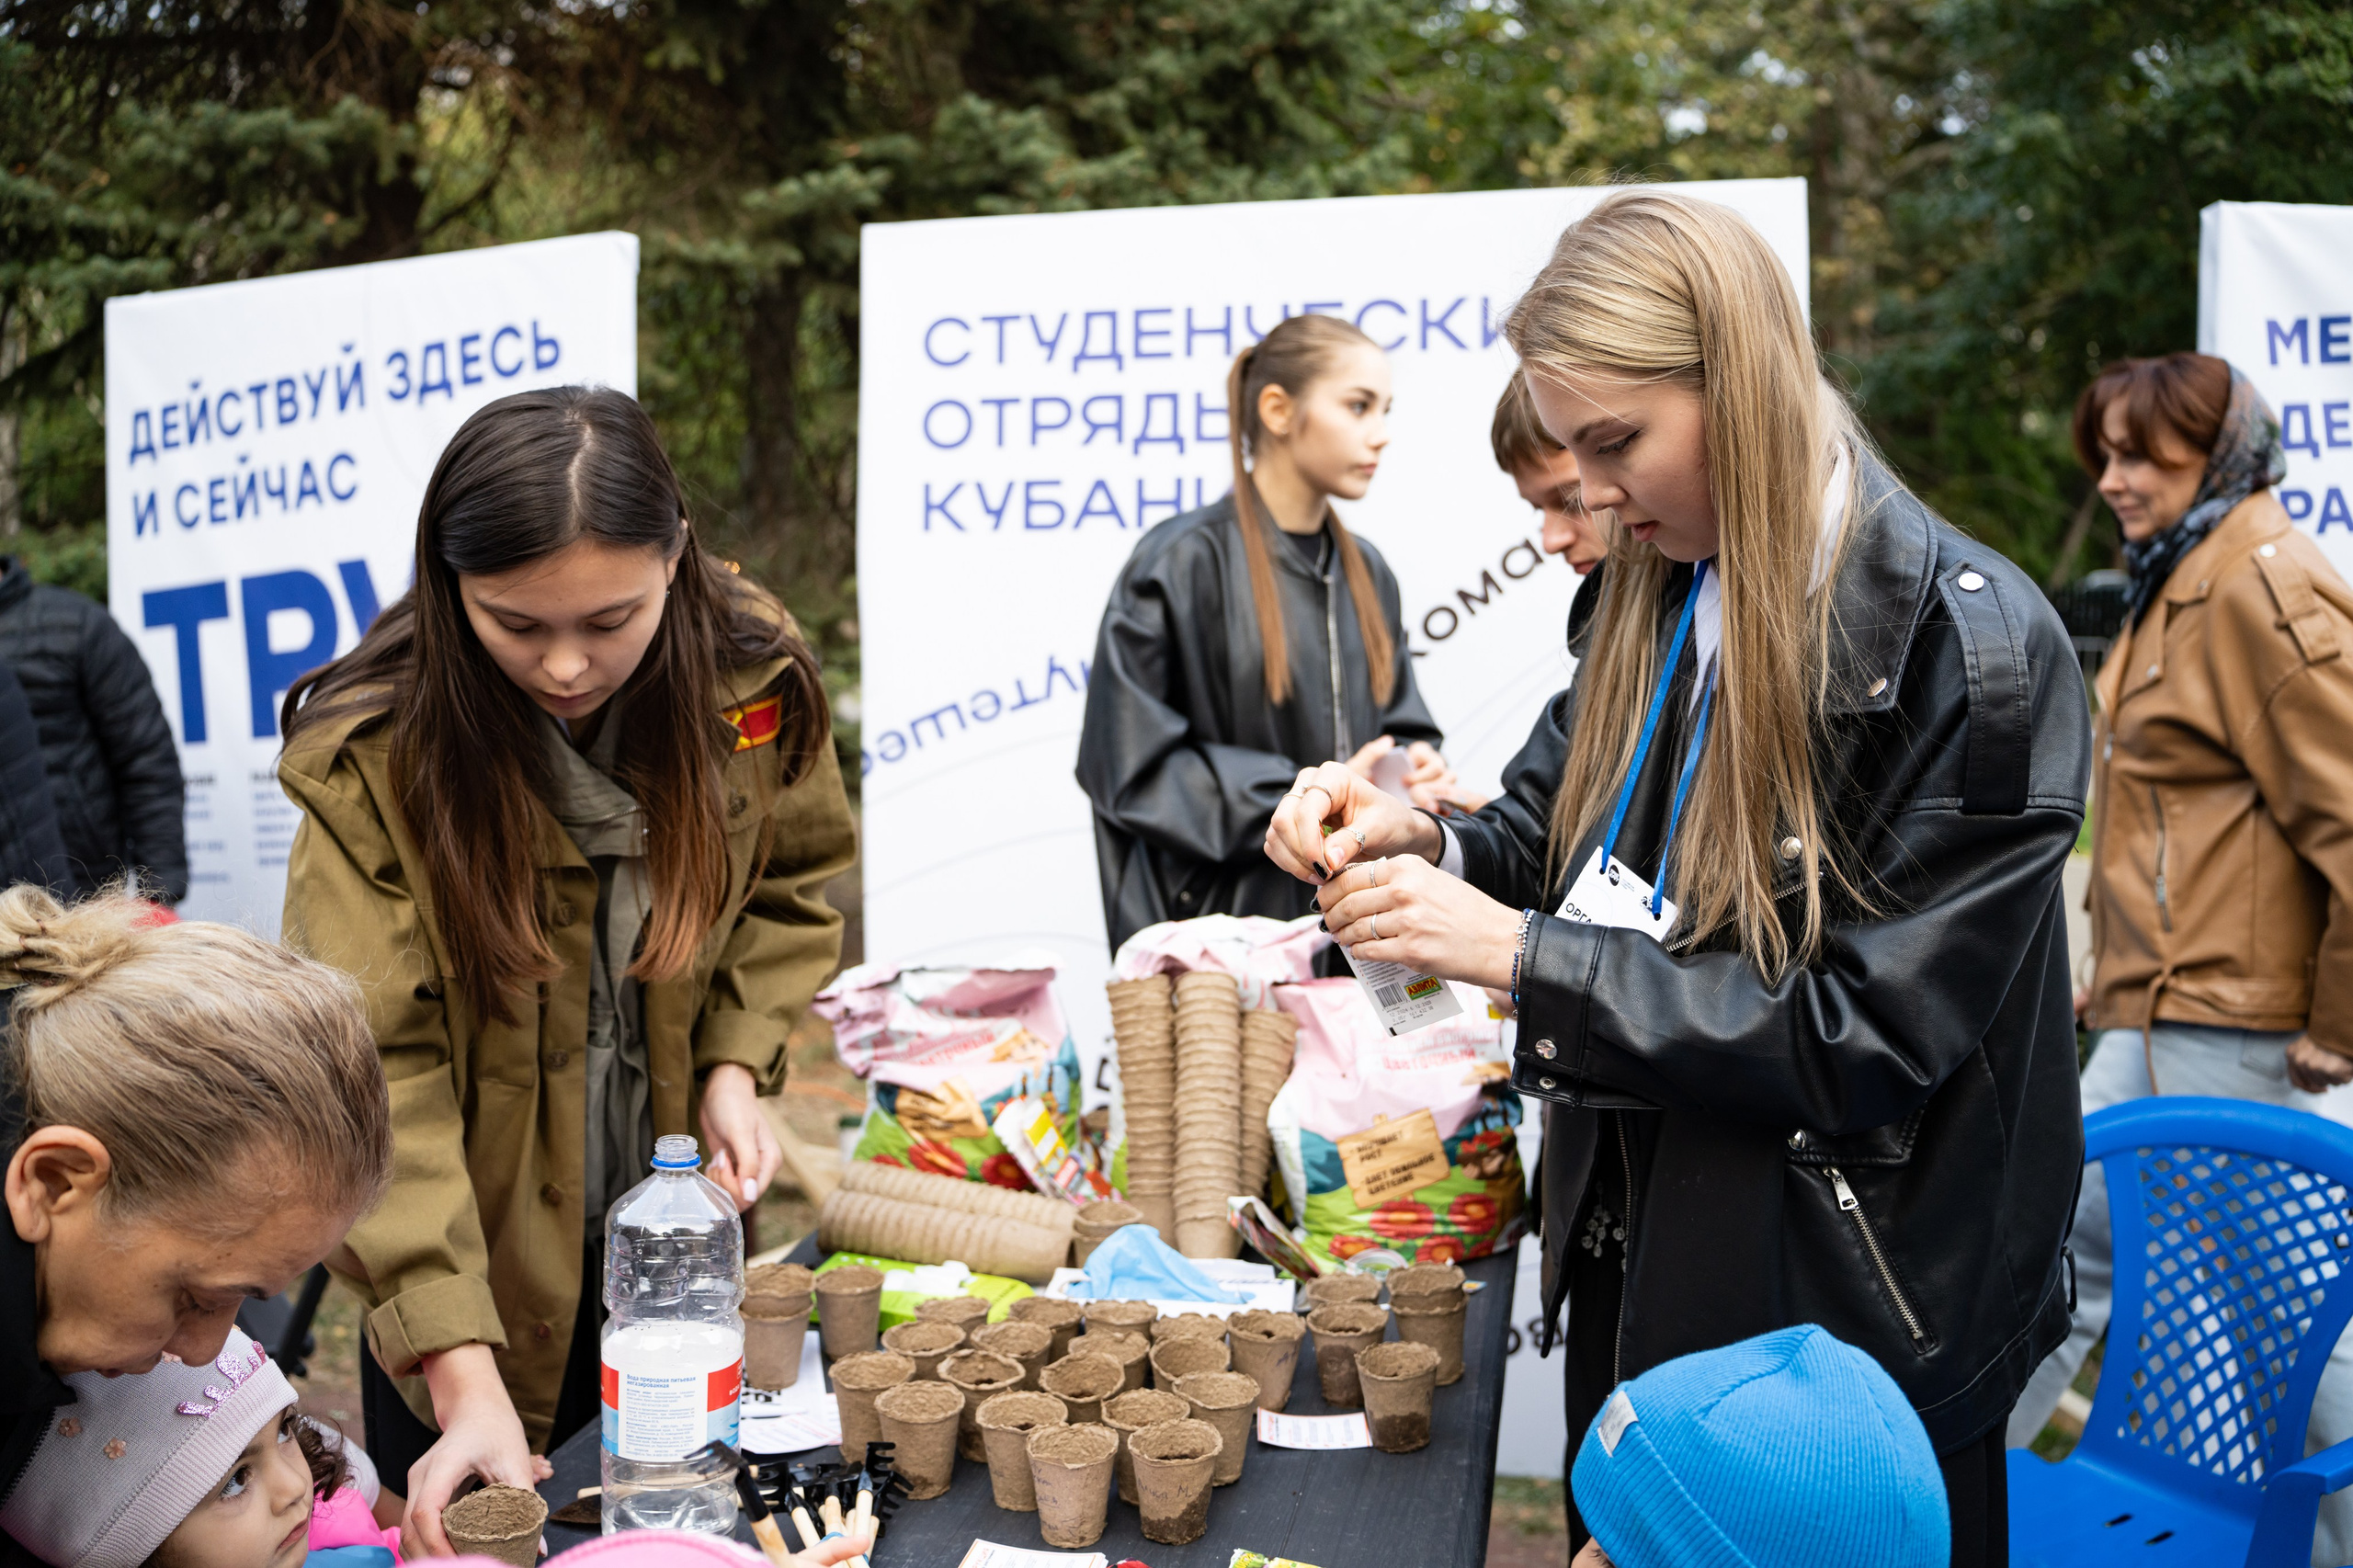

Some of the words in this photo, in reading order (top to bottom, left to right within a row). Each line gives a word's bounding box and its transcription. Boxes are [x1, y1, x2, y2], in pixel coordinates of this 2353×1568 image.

[128, 341, 365, 466] ДЕЙСТВУЙ
[385, 319, 563, 405] ЗДЕСЬ
[133, 489, 160, 539] И
[174, 452, 359, 530] СЕЙЧАС
[923, 476, 1202, 531] КУБАН
[626, 1373, 640, 1381] Вода
[640, 1376, 670, 1384] природная
[626, 1381, 670, 1389] негазированная
